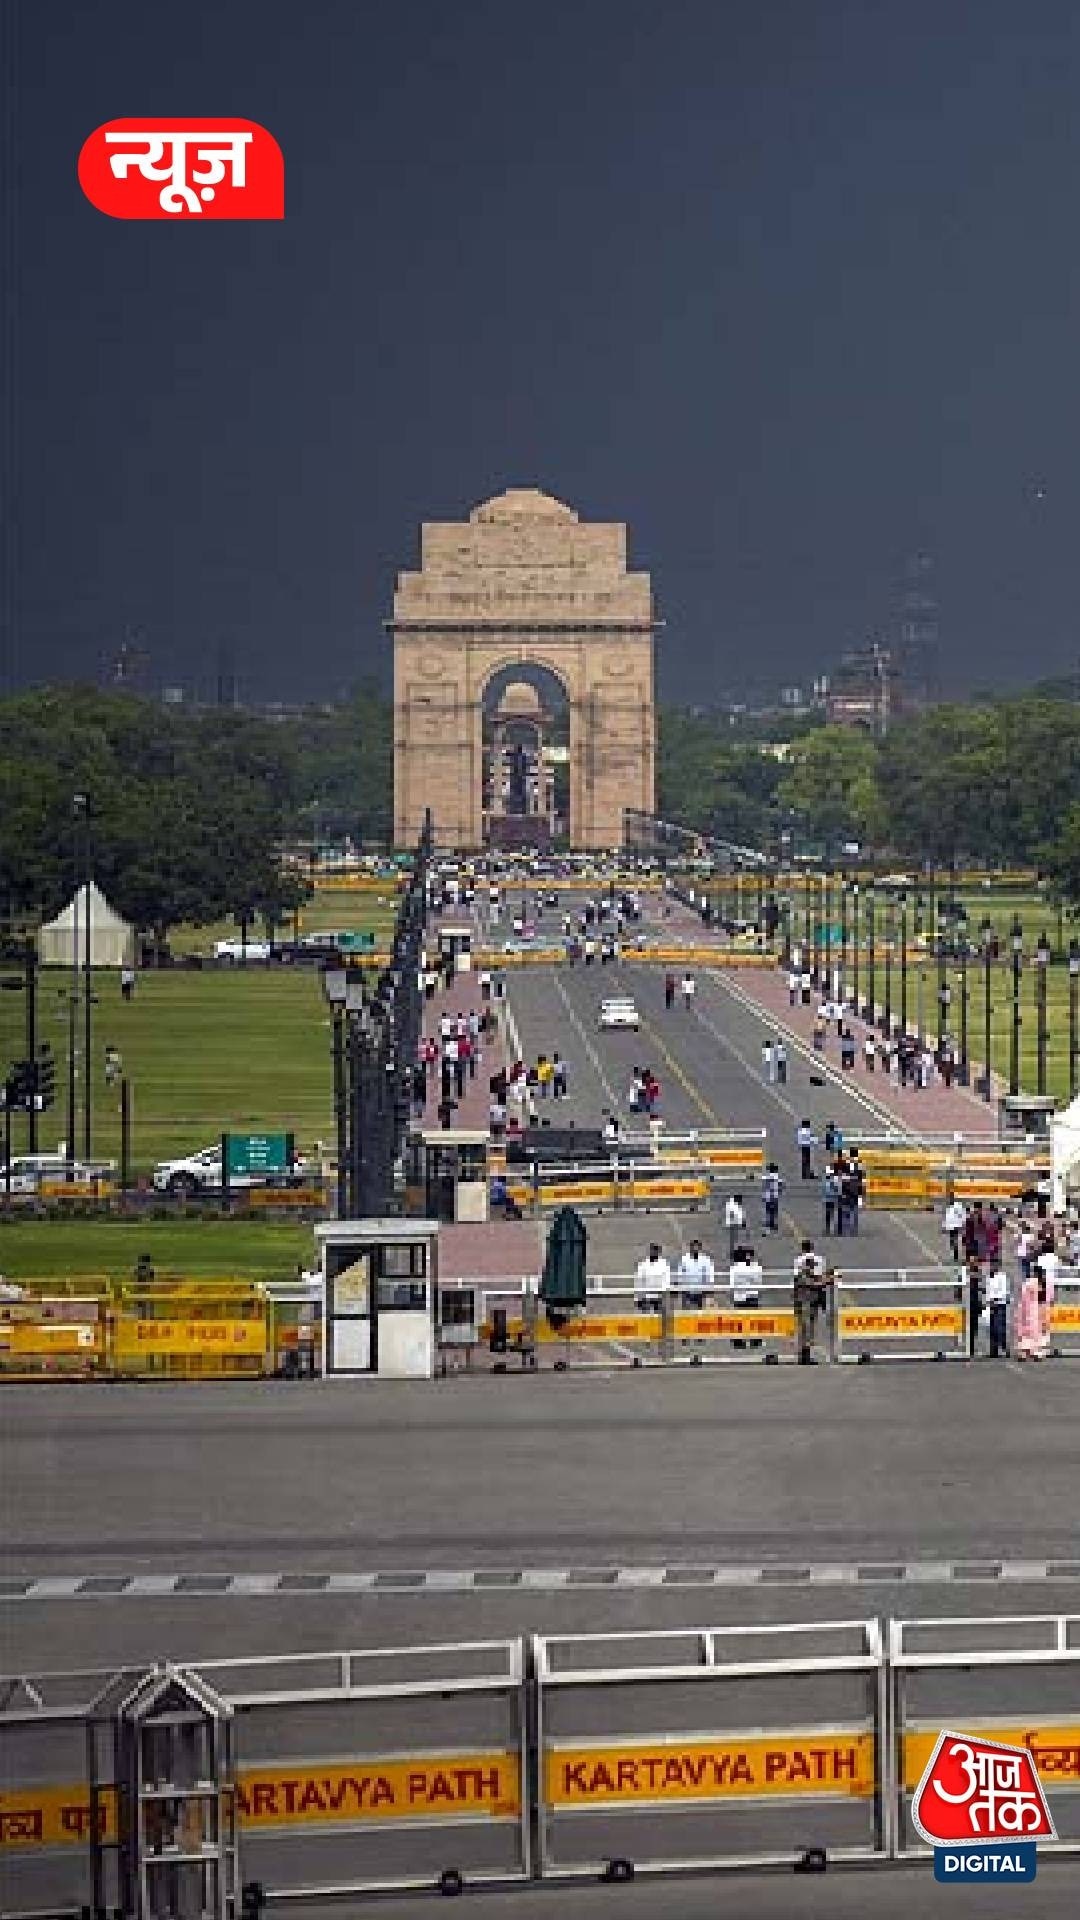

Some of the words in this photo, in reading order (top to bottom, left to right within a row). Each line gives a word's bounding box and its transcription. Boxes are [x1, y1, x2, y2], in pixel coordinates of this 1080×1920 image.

[226, 1777, 395, 1817] ARTAVYA
[409, 1768, 499, 1804] PATH
[562, 1754, 754, 1794] KARTAVYA
[765, 1748, 855, 1782] PATH
